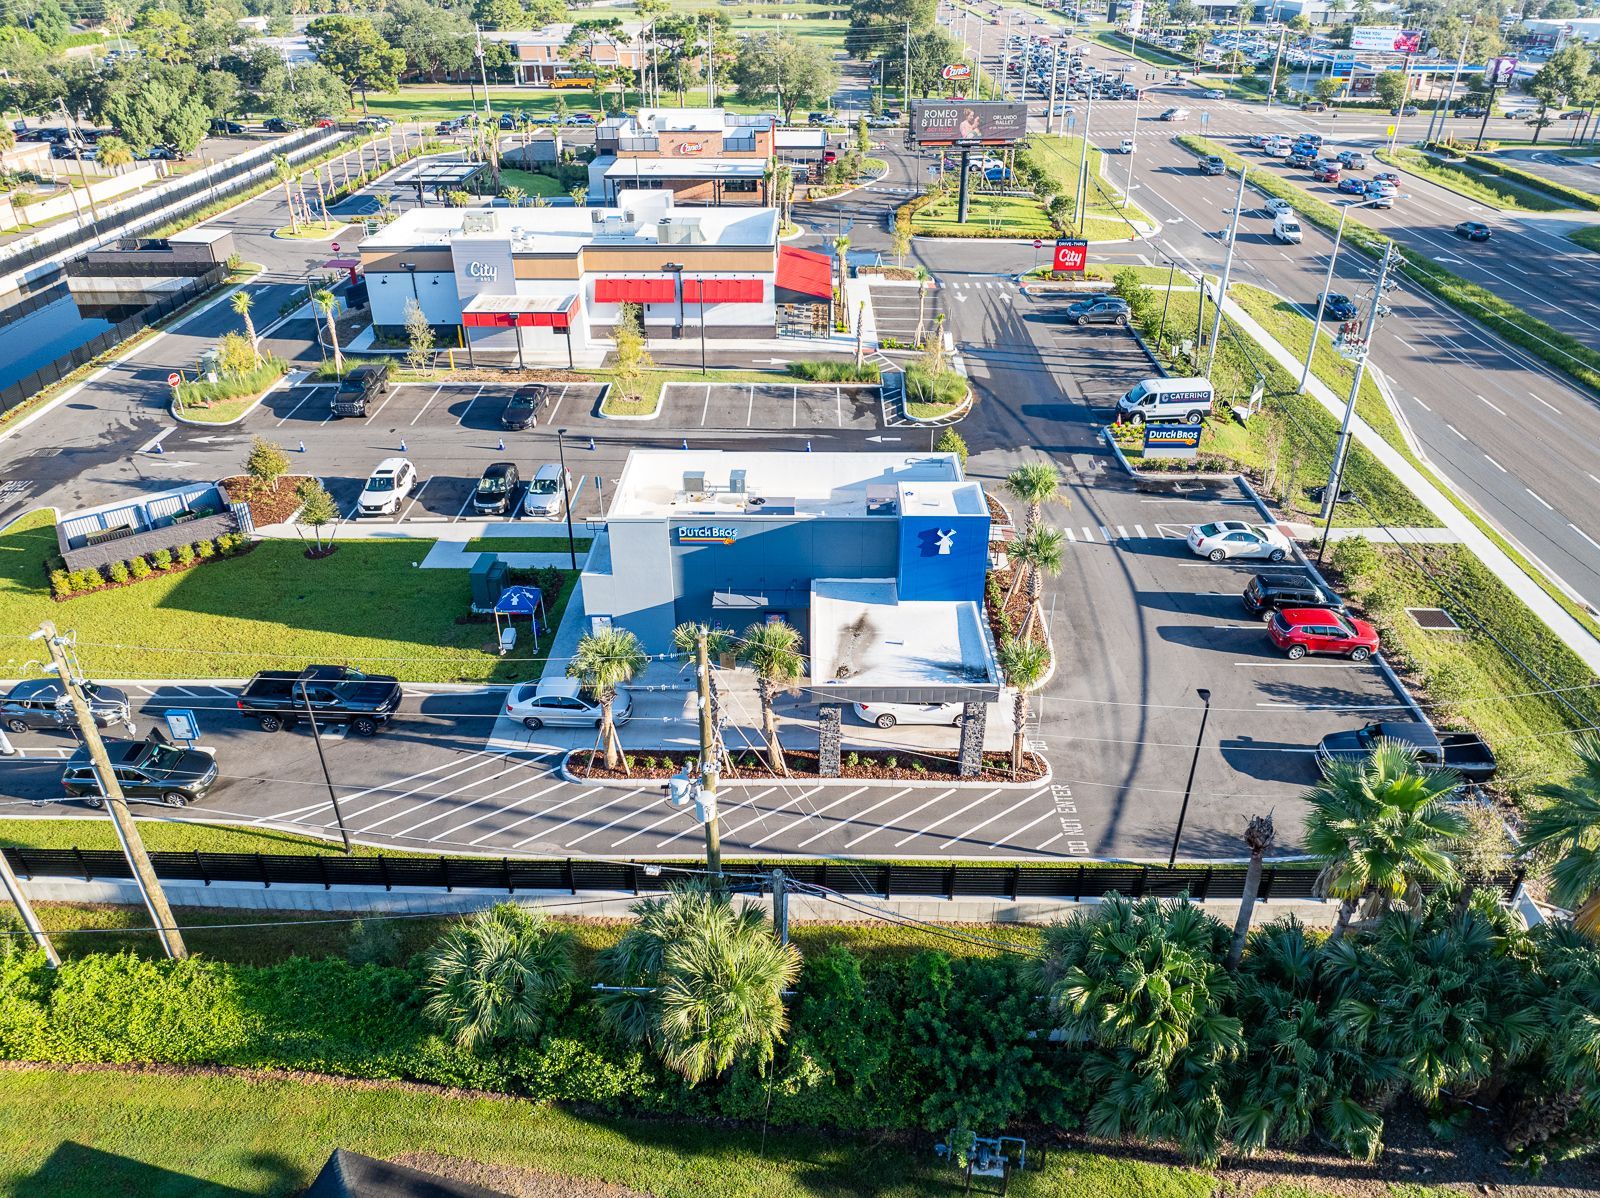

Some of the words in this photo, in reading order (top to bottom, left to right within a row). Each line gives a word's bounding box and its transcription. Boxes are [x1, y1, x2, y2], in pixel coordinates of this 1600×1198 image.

[924, 110, 958, 118] ROMEO
[929, 118, 958, 127] JULIET
[1059, 248, 1082, 266] City
[470, 261, 497, 282] City
[1170, 392, 1208, 400] CATERING
[1176, 430, 1198, 438] BROS
[712, 528, 738, 536] BROS
[1051, 784, 1078, 814] ENTER
[1060, 817, 1084, 836] NOT
[1068, 840, 1090, 854] DO
